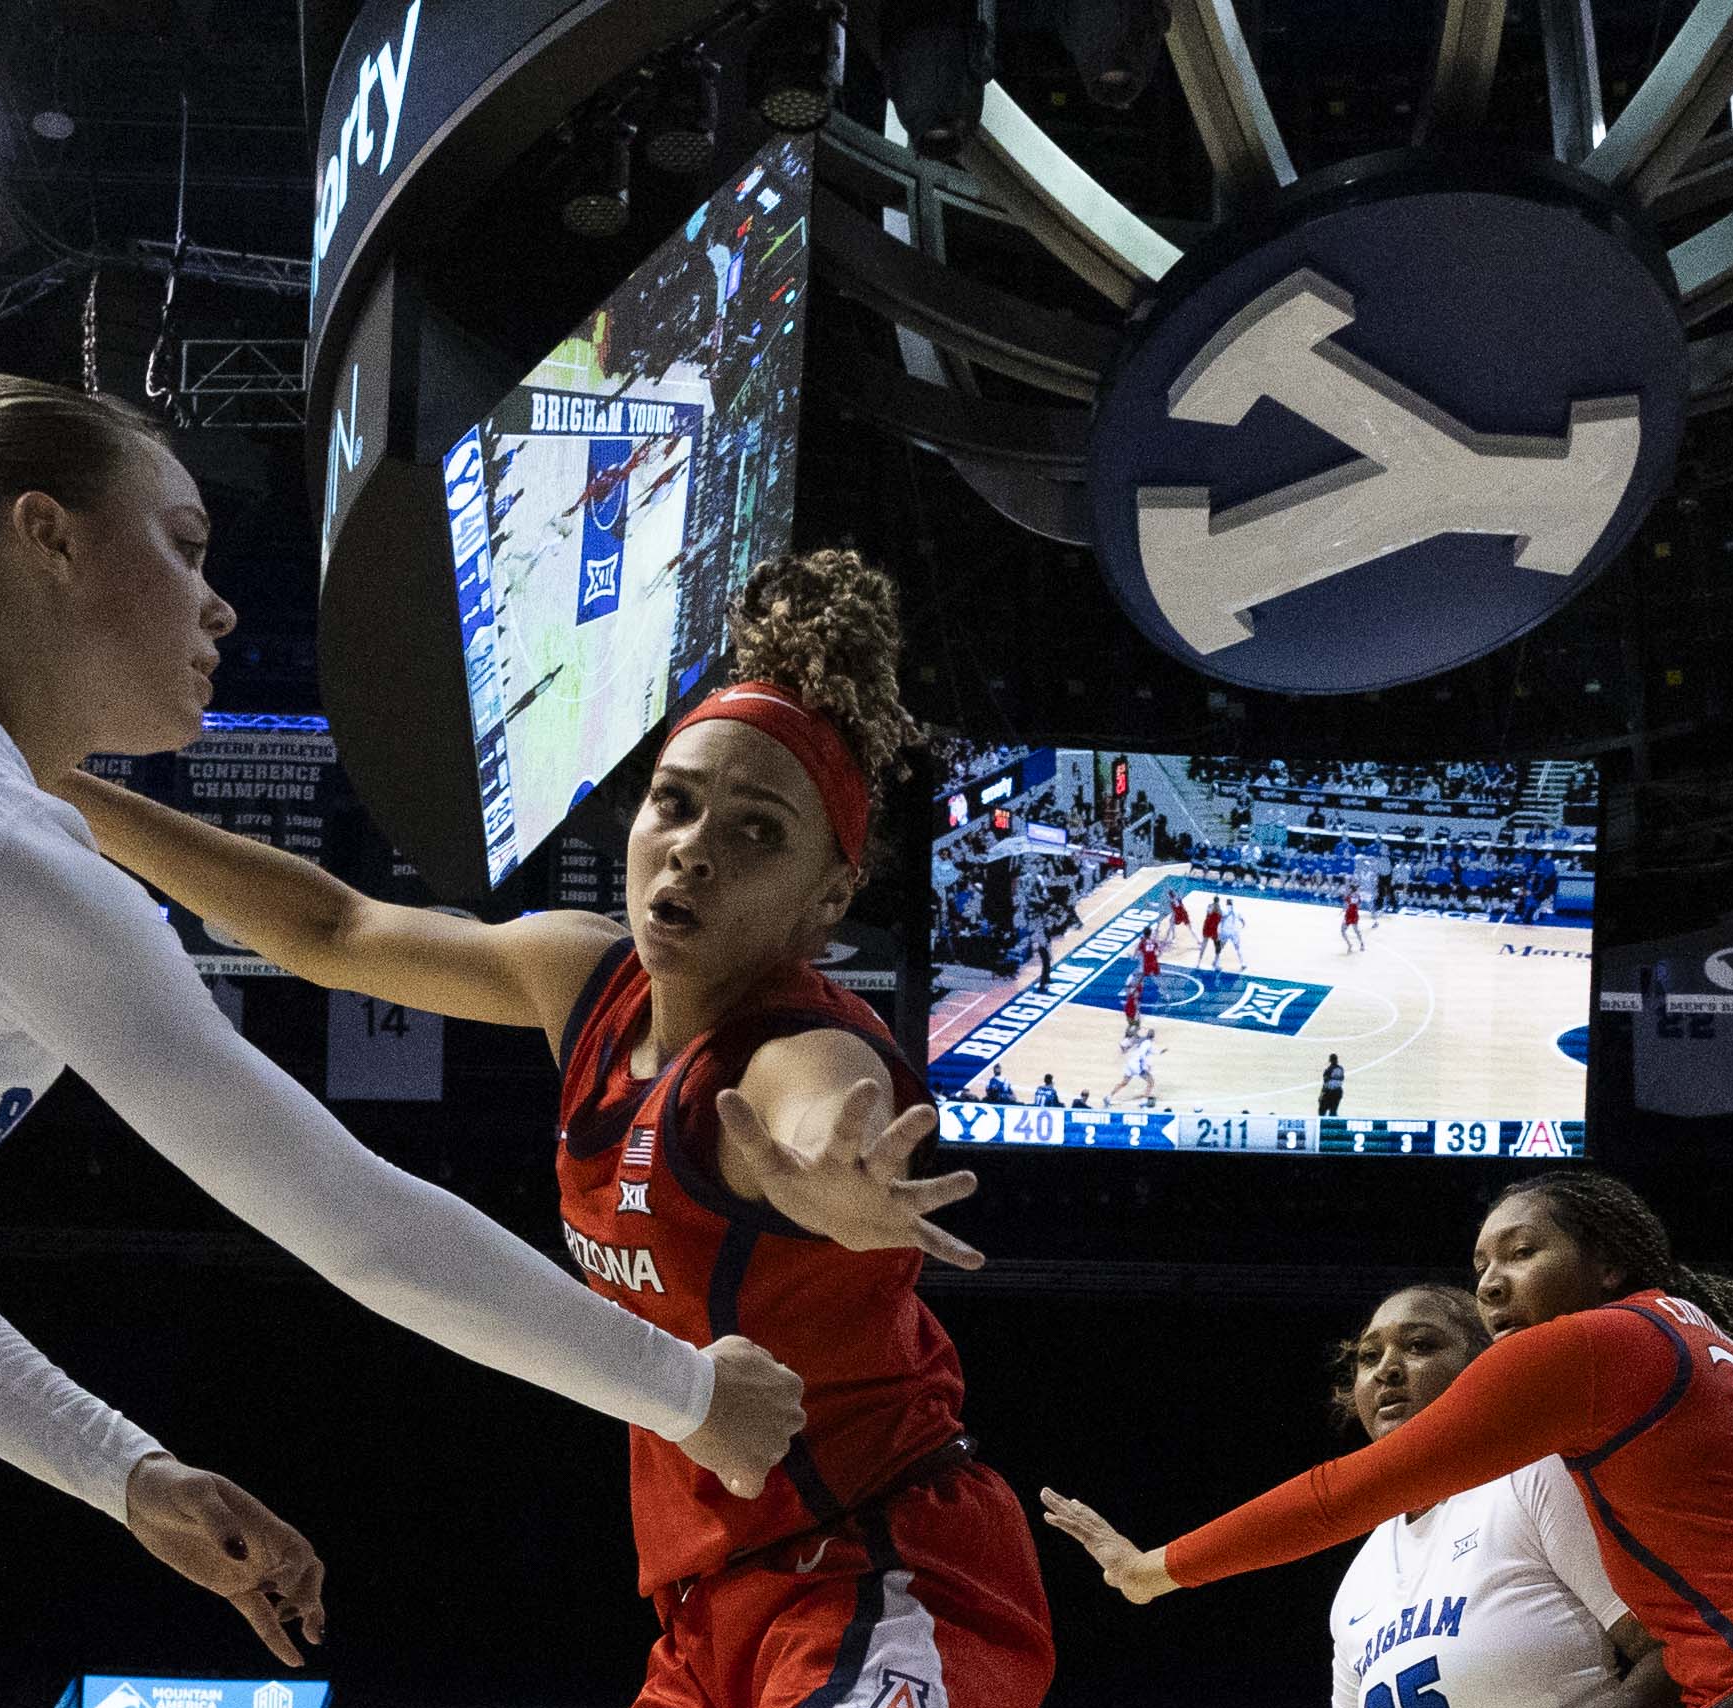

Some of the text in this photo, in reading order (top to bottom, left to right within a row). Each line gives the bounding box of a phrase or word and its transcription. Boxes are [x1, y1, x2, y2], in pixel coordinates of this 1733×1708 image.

[317, 0, 421, 262] arty
[532, 394, 676, 435] BRIGHAM YOUNG
[1135, 268, 1641, 655] Y
[257, 742, 334, 758] ATHLETIC
[189, 761, 322, 783] CONFERENCE
[192, 782, 316, 802] CHAMPIONS
[956, 908, 1161, 1061] BRIGHAM YOUNG
[362, 1001, 410, 1038] 14
[1012, 1109, 1054, 1141] 40
[1196, 1117, 1250, 1149] 2:11
[1446, 1121, 1487, 1153] 39
[1084, 1125, 1096, 1145] 2
[1129, 1126, 1141, 1146] 2
[1353, 1133, 1365, 1152] 2
[1400, 1133, 1412, 1153] 3
[563, 1221, 665, 1293] RIZONA
[1355, 1595, 1468, 1680] BRIGHAM
[152, 1686, 223, 1702] MOUNTAIN
